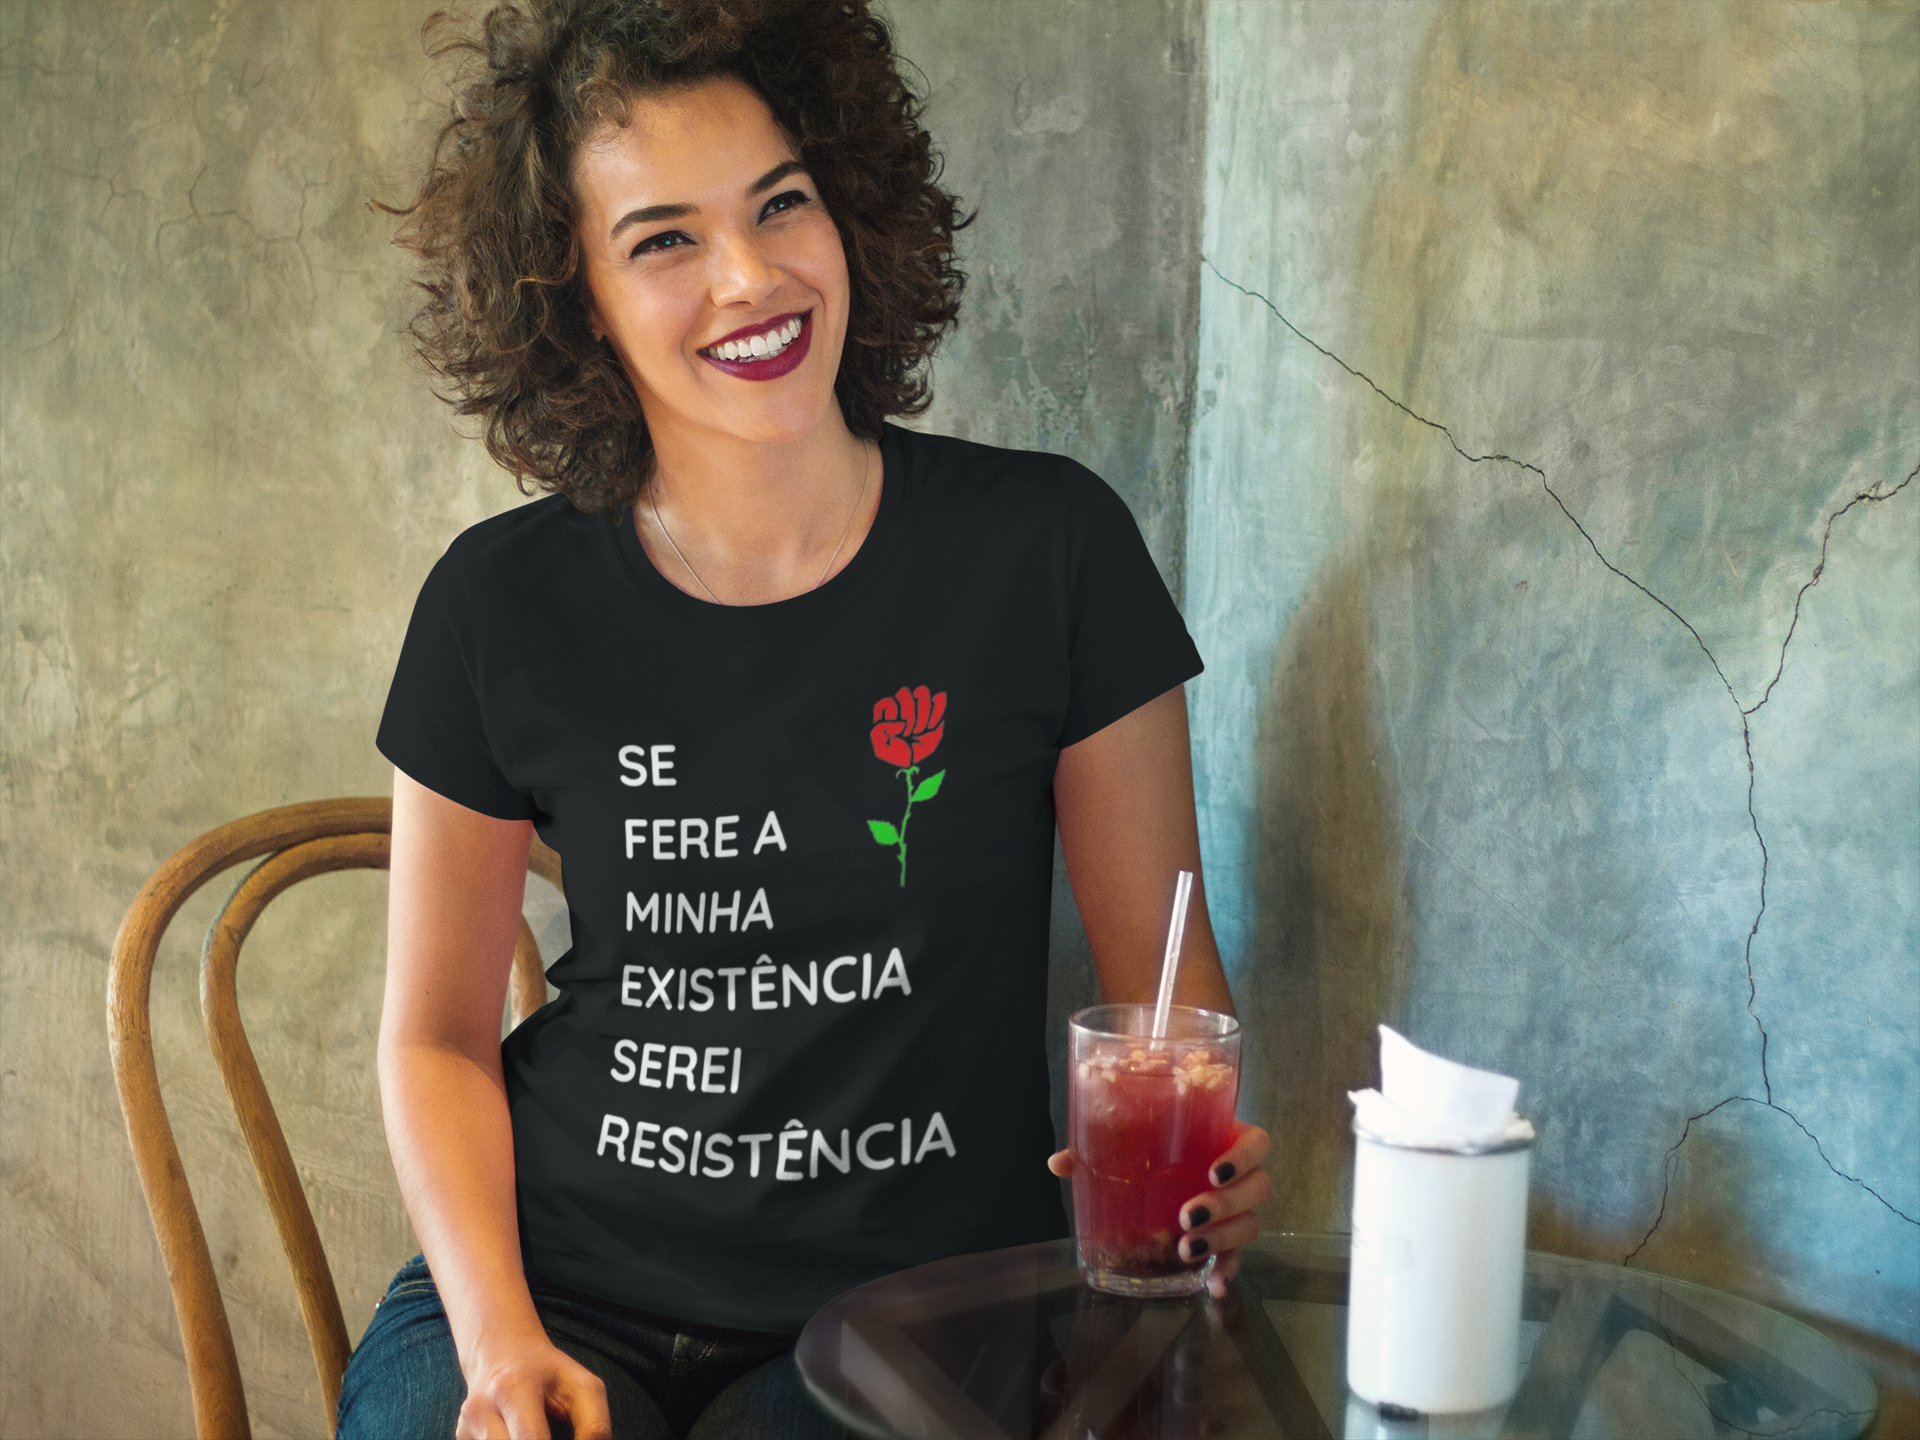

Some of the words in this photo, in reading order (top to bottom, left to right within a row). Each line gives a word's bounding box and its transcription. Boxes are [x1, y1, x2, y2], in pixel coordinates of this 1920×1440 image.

[618, 744, 677, 787] SE
[624, 815, 740, 860] FERE
[753, 810, 788, 855] A
[625, 887, 774, 934] MINHA
[621, 947, 912, 1012] EXISTÊNCIA
[610, 1038, 742, 1095] SEREI
[596, 1112, 956, 1181] RESISTÊNCIA
